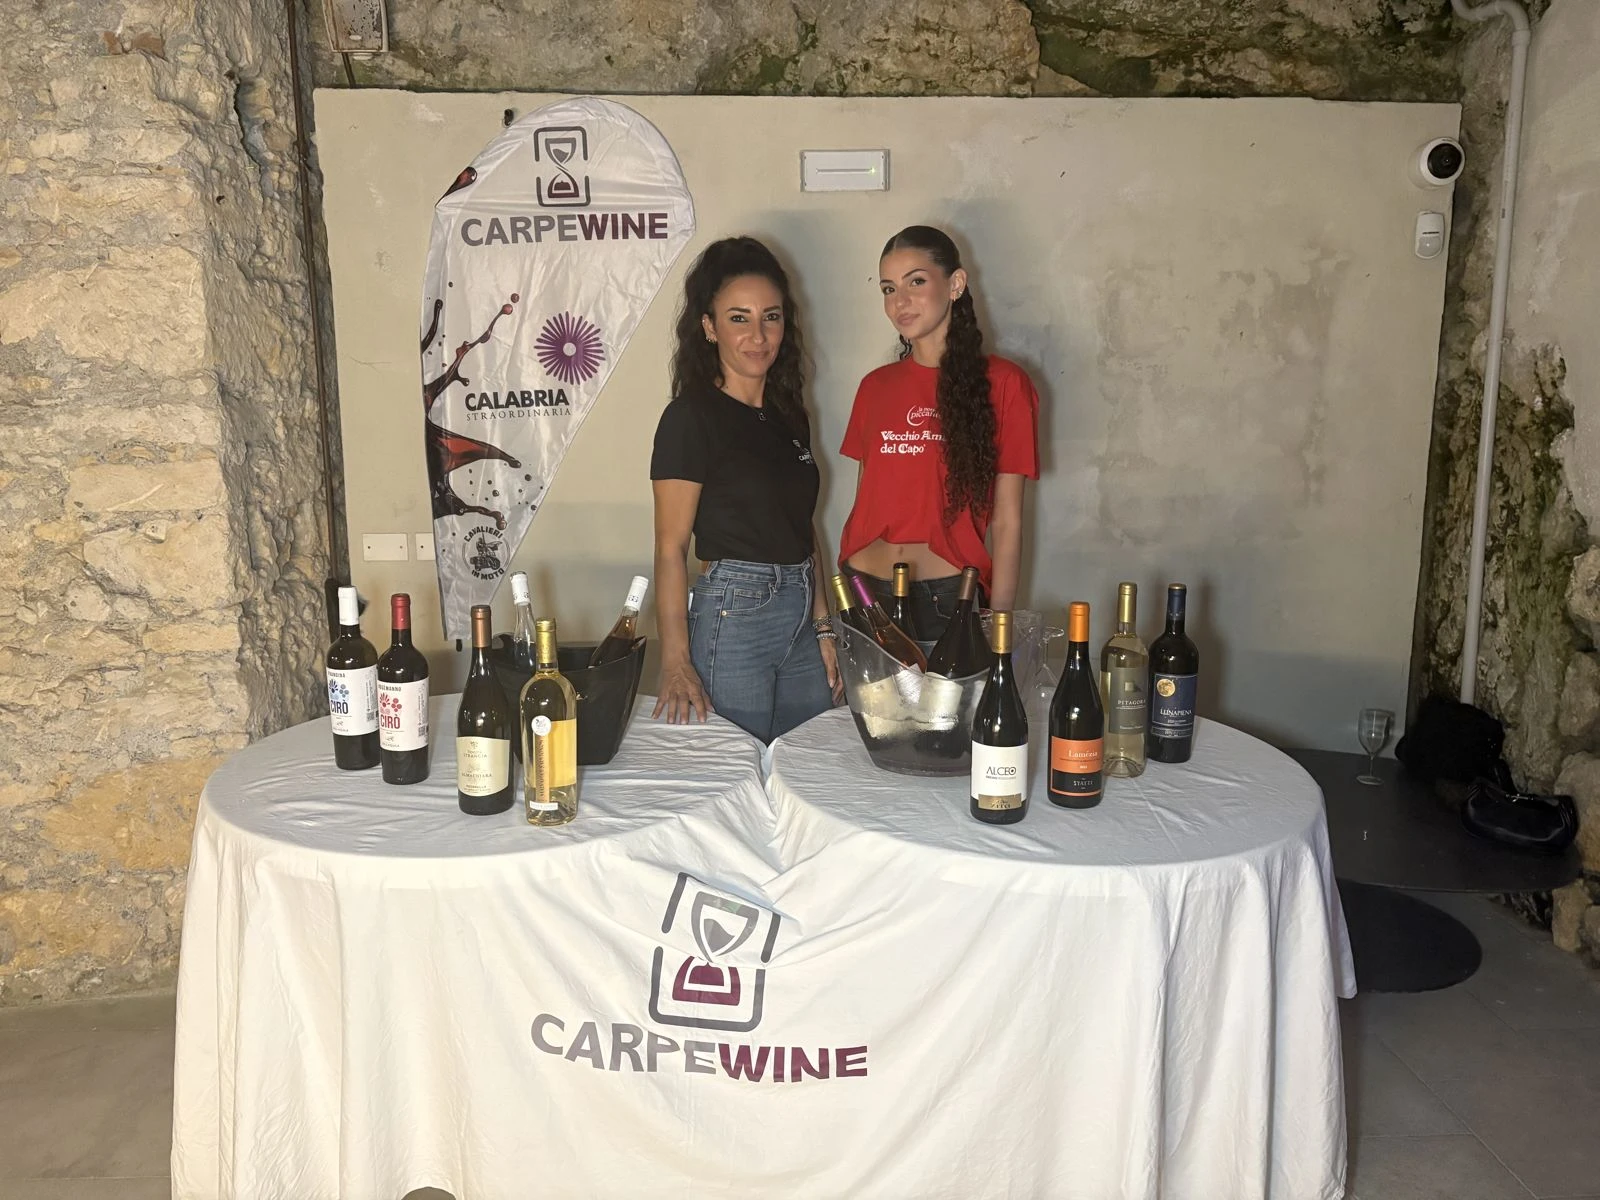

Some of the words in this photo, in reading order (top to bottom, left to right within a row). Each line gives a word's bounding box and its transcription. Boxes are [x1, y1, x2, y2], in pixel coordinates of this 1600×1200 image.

[461, 213, 668, 247] CARPEWINE
[465, 388, 569, 412] CALABRIA
[466, 409, 572, 421] STRAORDINARIA
[880, 430, 920, 441] Vecchio
[880, 443, 896, 454] del
[898, 443, 925, 455] Capo
[464, 526, 503, 542] CAVALIERI
[471, 569, 480, 578] IN
[480, 567, 505, 580] MOTO
[330, 699, 349, 715] CIRÒ
[380, 713, 401, 729] CIRÒ
[986, 766, 1017, 776] ALCEO
[530, 1013, 868, 1083] CARPEWINE
